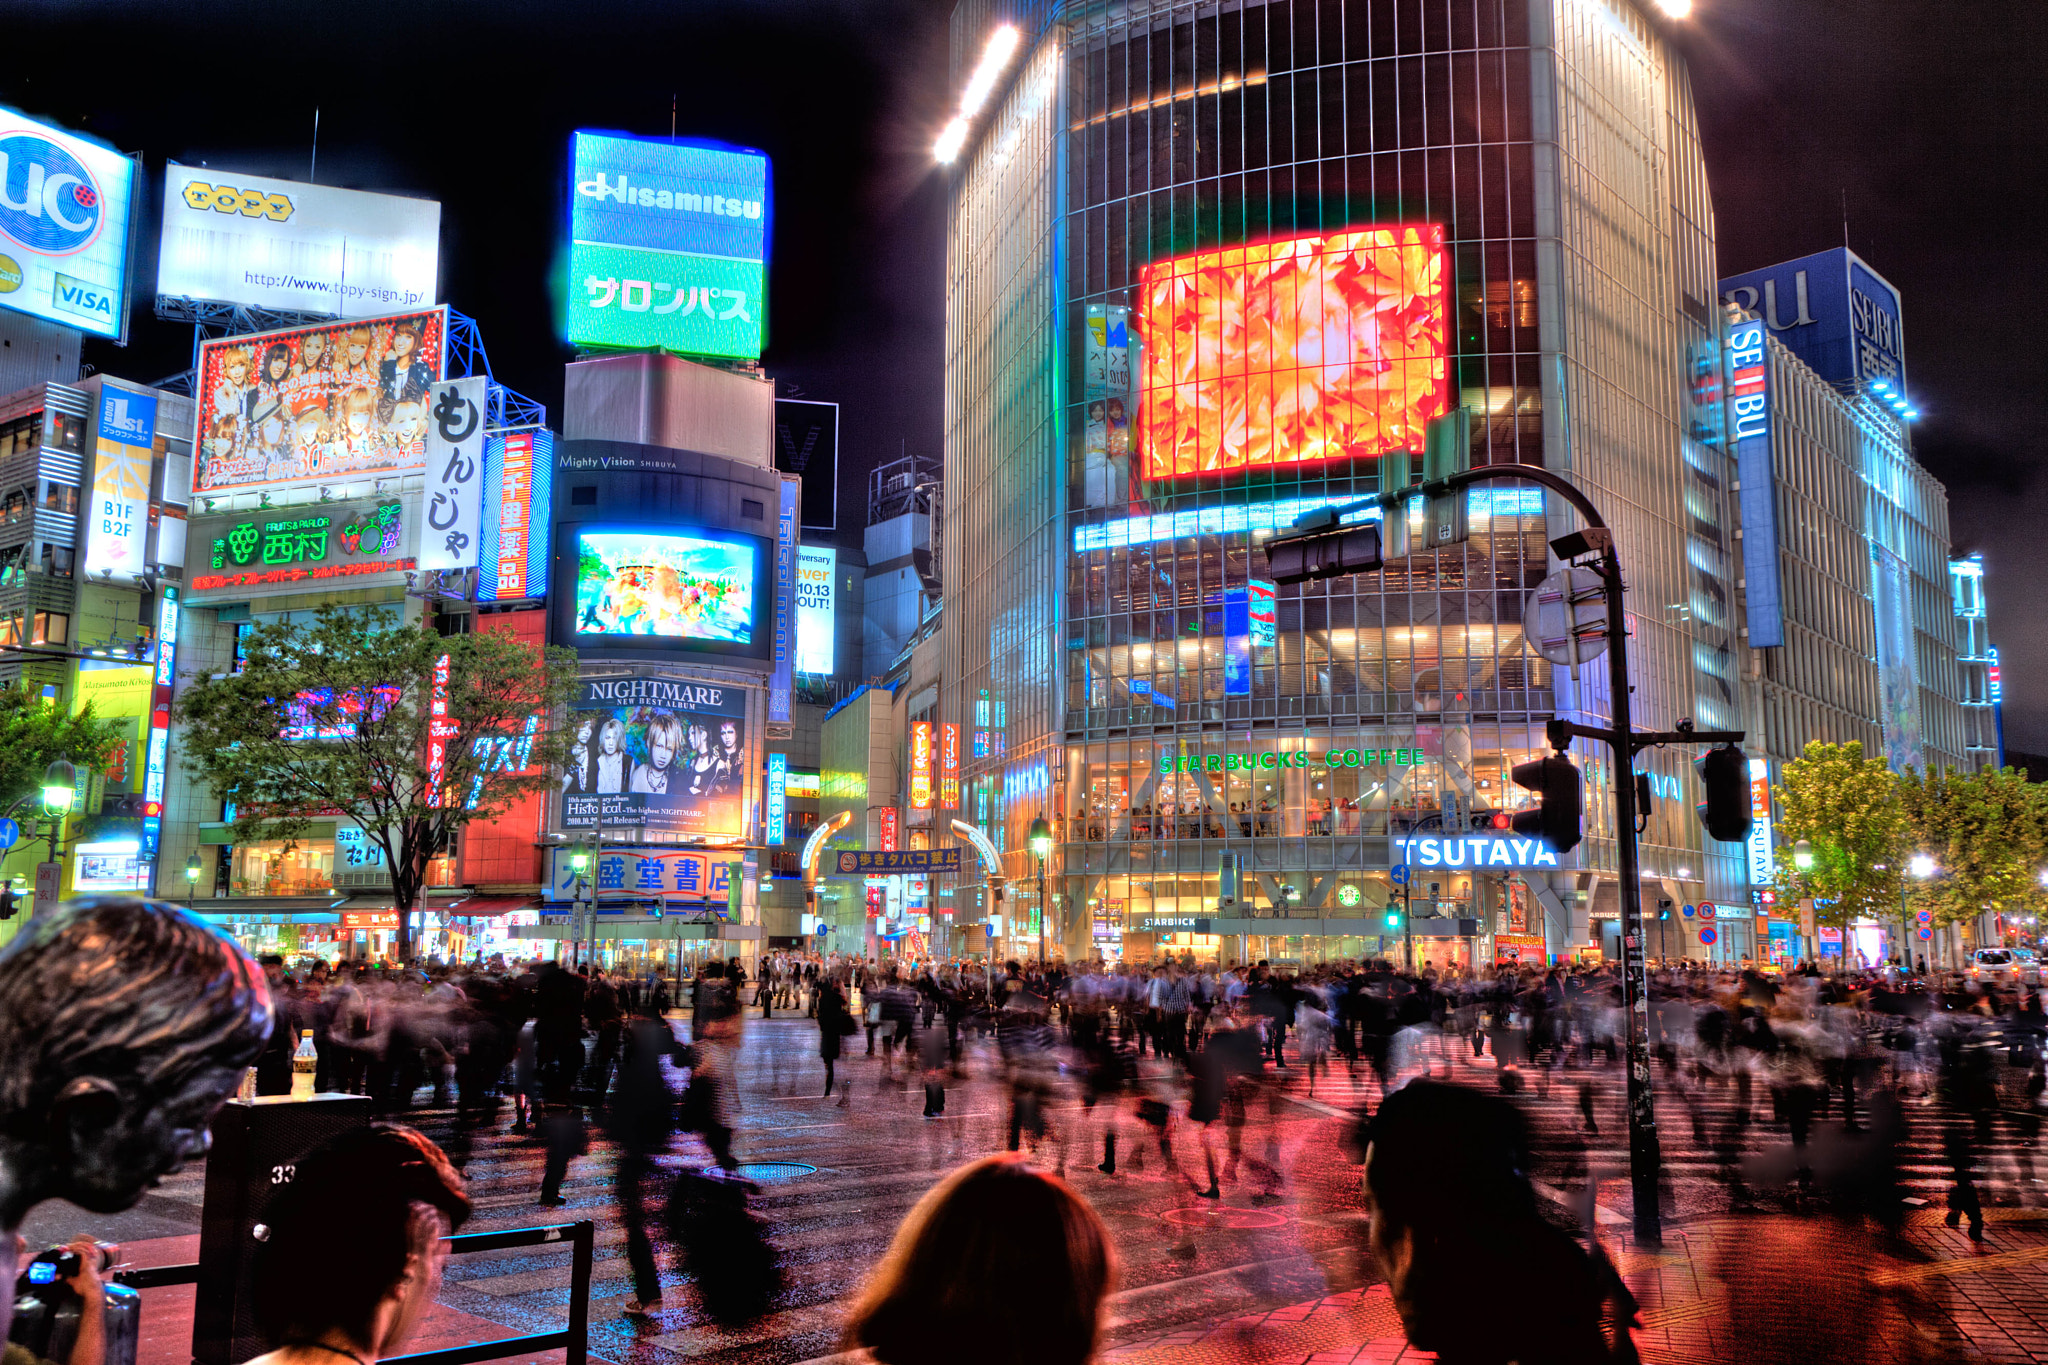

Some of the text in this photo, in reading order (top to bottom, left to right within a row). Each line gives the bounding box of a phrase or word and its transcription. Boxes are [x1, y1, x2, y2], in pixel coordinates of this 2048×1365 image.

[191, 190, 287, 214] TOPY
[58, 282, 111, 314] VISA
[245, 270, 424, 305] http://www.topy-sign.jp/
[584, 275, 750, 323] サロンパス
[1852, 287, 1901, 361] SEIBU
[1731, 329, 1766, 440] SEIBU
[103, 426, 147, 442] ブックファースト
[429, 386, 479, 560] もんじゃ
[560, 455, 677, 469] Mighty Vision SHIBUYA
[104, 501, 133, 519] B1F
[498, 440, 525, 588] 三千里薬品
[103, 522, 132, 537] B2F
[212, 539, 225, 570] 渋谷
[263, 529, 328, 564] 西村
[799, 553, 831, 565] iversary
[776, 507, 794, 662] Taisei neon
[83, 677, 152, 689] Matsumoto KiYos
[590, 680, 723, 706] NIGHTMARE
[617, 697, 696, 710] NEW BEST ALBUM
[1159, 748, 1424, 774] STARBUCKS COFFEE
[567, 802, 622, 815] Histoical
[638, 807, 660, 815] highest
[580, 796, 612, 804] anniveary
[770, 759, 783, 839] 大盛堂商事ビル
[859, 851, 958, 866] 歩きタバコ禁止
[1396, 839, 1557, 866] TSUTAYA
[1752, 818, 1768, 885] TSUTAYA
[561, 857, 730, 891] 大盛堂書店
[1144, 917, 1196, 928] STARBUCK
[271, 1165, 296, 1184] 33
